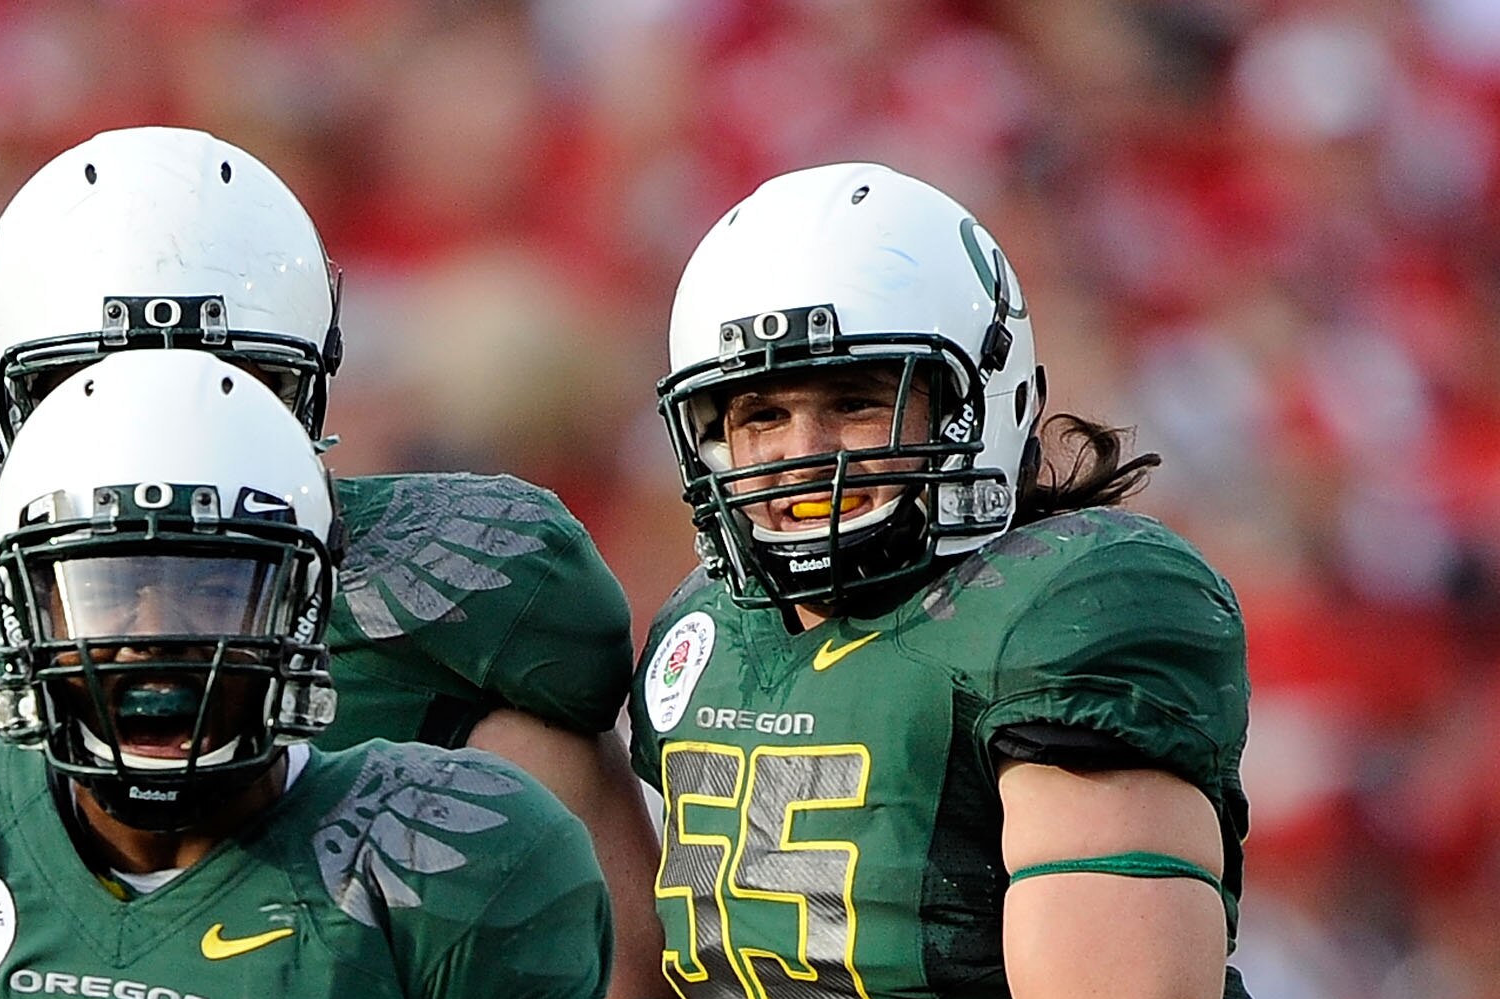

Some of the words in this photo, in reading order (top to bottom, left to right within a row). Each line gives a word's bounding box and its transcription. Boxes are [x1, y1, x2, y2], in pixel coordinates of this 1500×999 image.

[144, 298, 182, 328] O
[753, 311, 789, 340] O
[134, 482, 174, 509] O
[696, 706, 815, 736] OREGON
